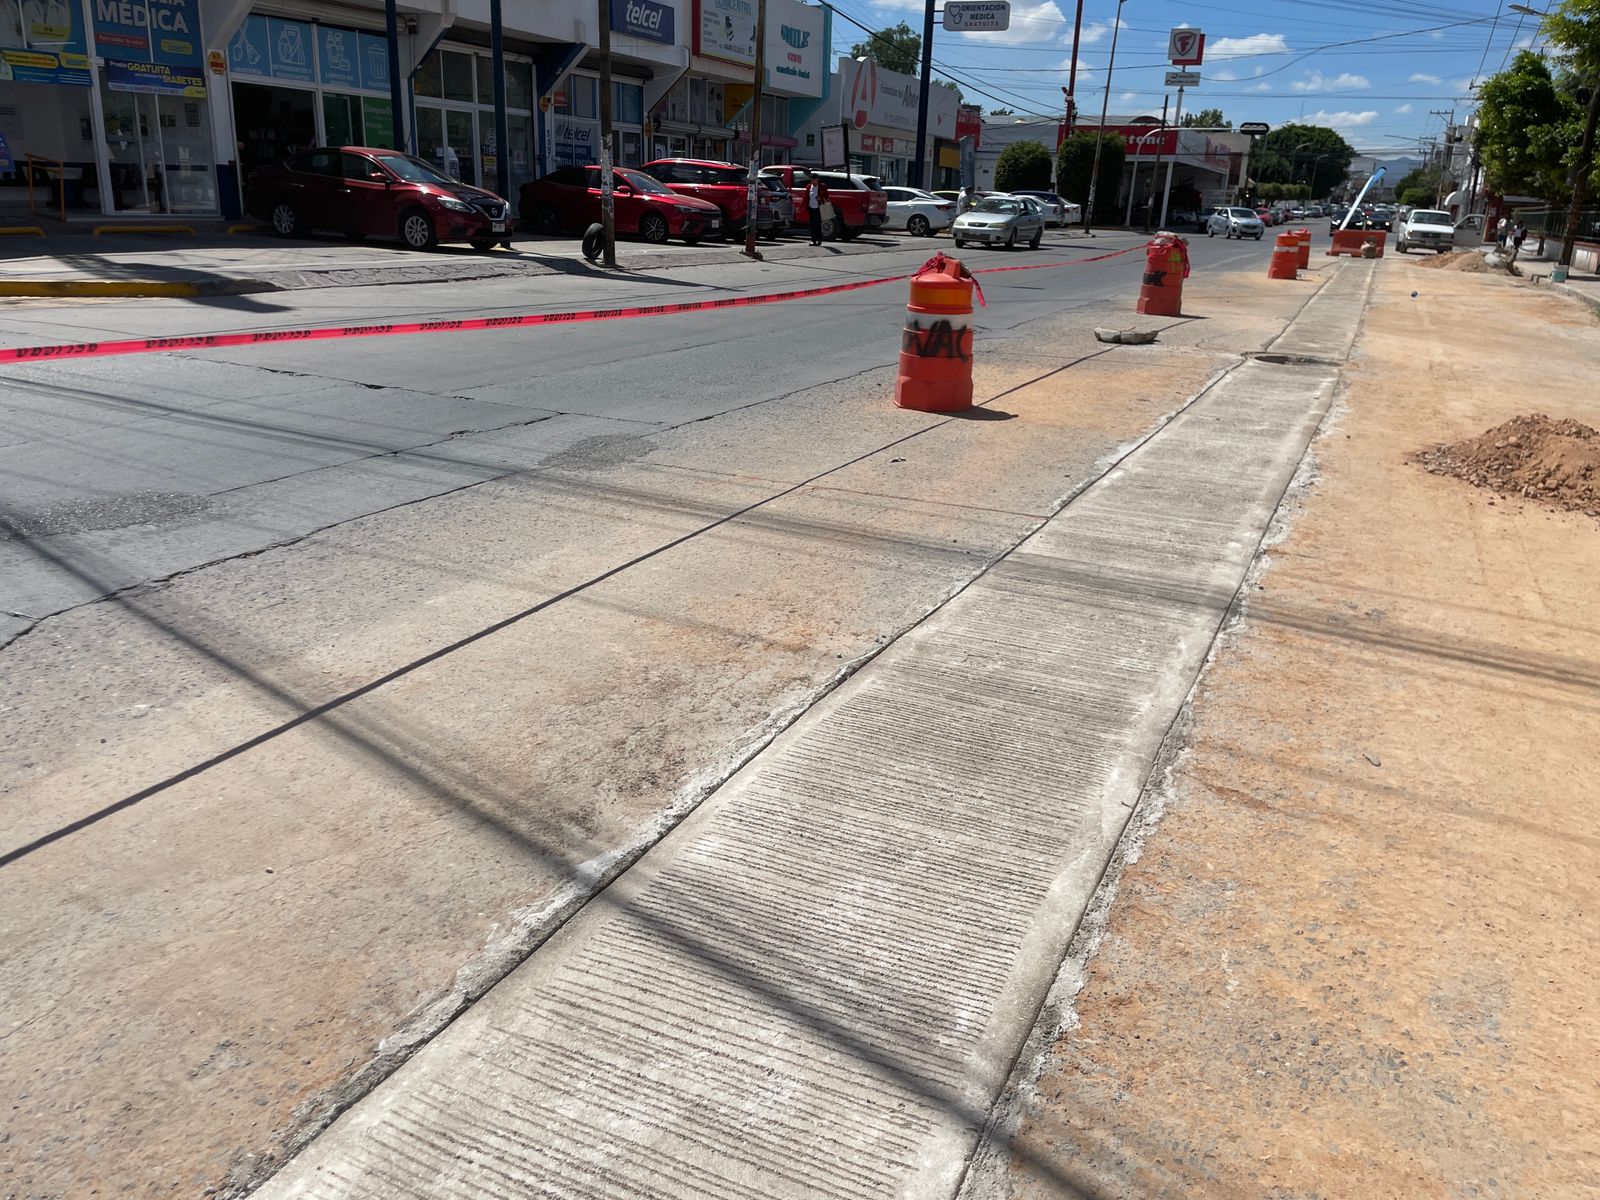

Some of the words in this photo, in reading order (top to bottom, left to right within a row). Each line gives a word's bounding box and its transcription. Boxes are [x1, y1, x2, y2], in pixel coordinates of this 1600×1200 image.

[626, 0, 662, 29] telcel
[961, 4, 1006, 12] ORIENTACIÓN
[97, 0, 189, 33] MÉDICA
[781, 24, 811, 49] SMILE
[127, 62, 171, 75] GRATUITA
[163, 75, 203, 87] DIABETES
[564, 126, 592, 141] telcel
